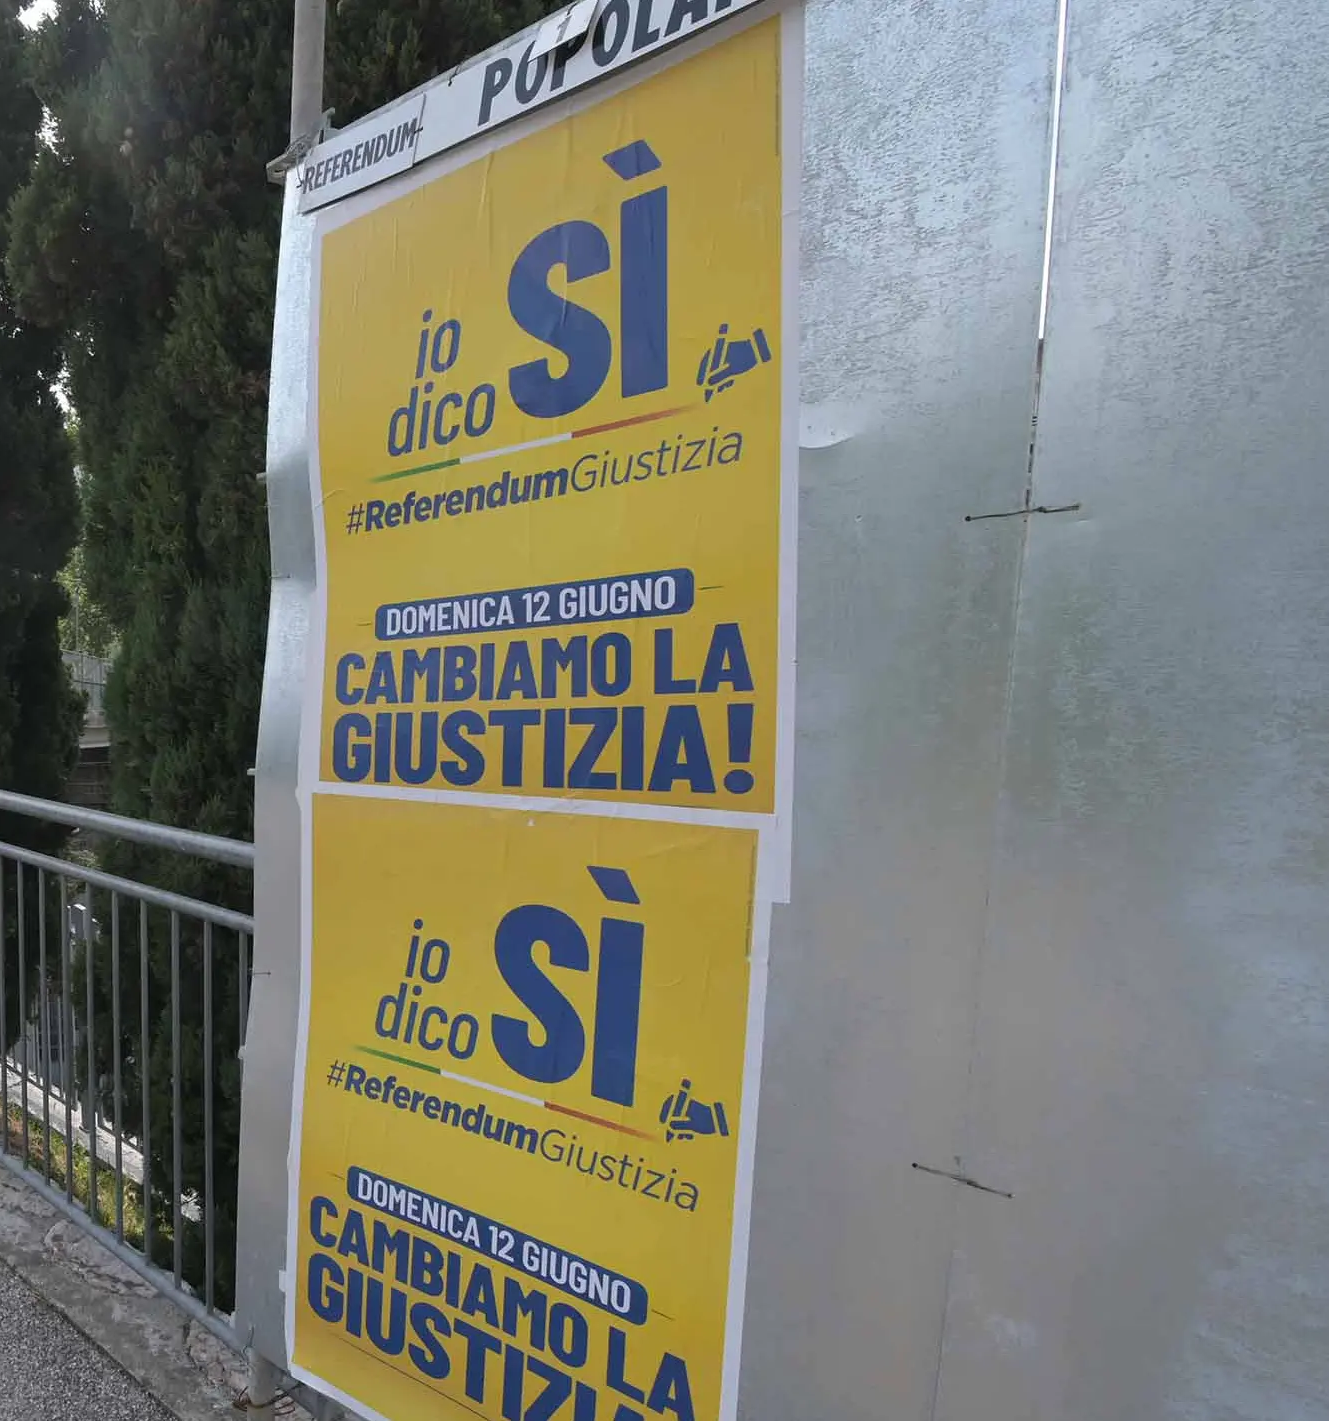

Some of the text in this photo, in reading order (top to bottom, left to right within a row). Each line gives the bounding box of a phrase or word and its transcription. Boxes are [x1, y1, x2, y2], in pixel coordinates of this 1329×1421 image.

[478, 0, 734, 126] POPOLA
[301, 117, 418, 195] REFERENDUM
[507, 139, 669, 419] SÌ
[414, 309, 462, 380] io
[387, 382, 497, 458] dico
[345, 427, 744, 536] #ReferendumGiustizia
[385, 575, 677, 636] DOMENICA 12 GIUGNO
[335, 622, 755, 706] CAMBIAMO LA
[332, 703, 756, 796] GIUSTIZIA!
[404, 918, 451, 985] io
[490, 865, 645, 1108] SÌ
[374, 982, 480, 1061] dico
[326, 1058, 701, 1212] #ReferendumGiustizia
[356, 1171, 632, 1314] DOMENICA 12 GIUGNO
[307, 1251, 645, 1421] GIUSTIZI
[309, 1194, 697, 1421] CAMBIAMO LA
